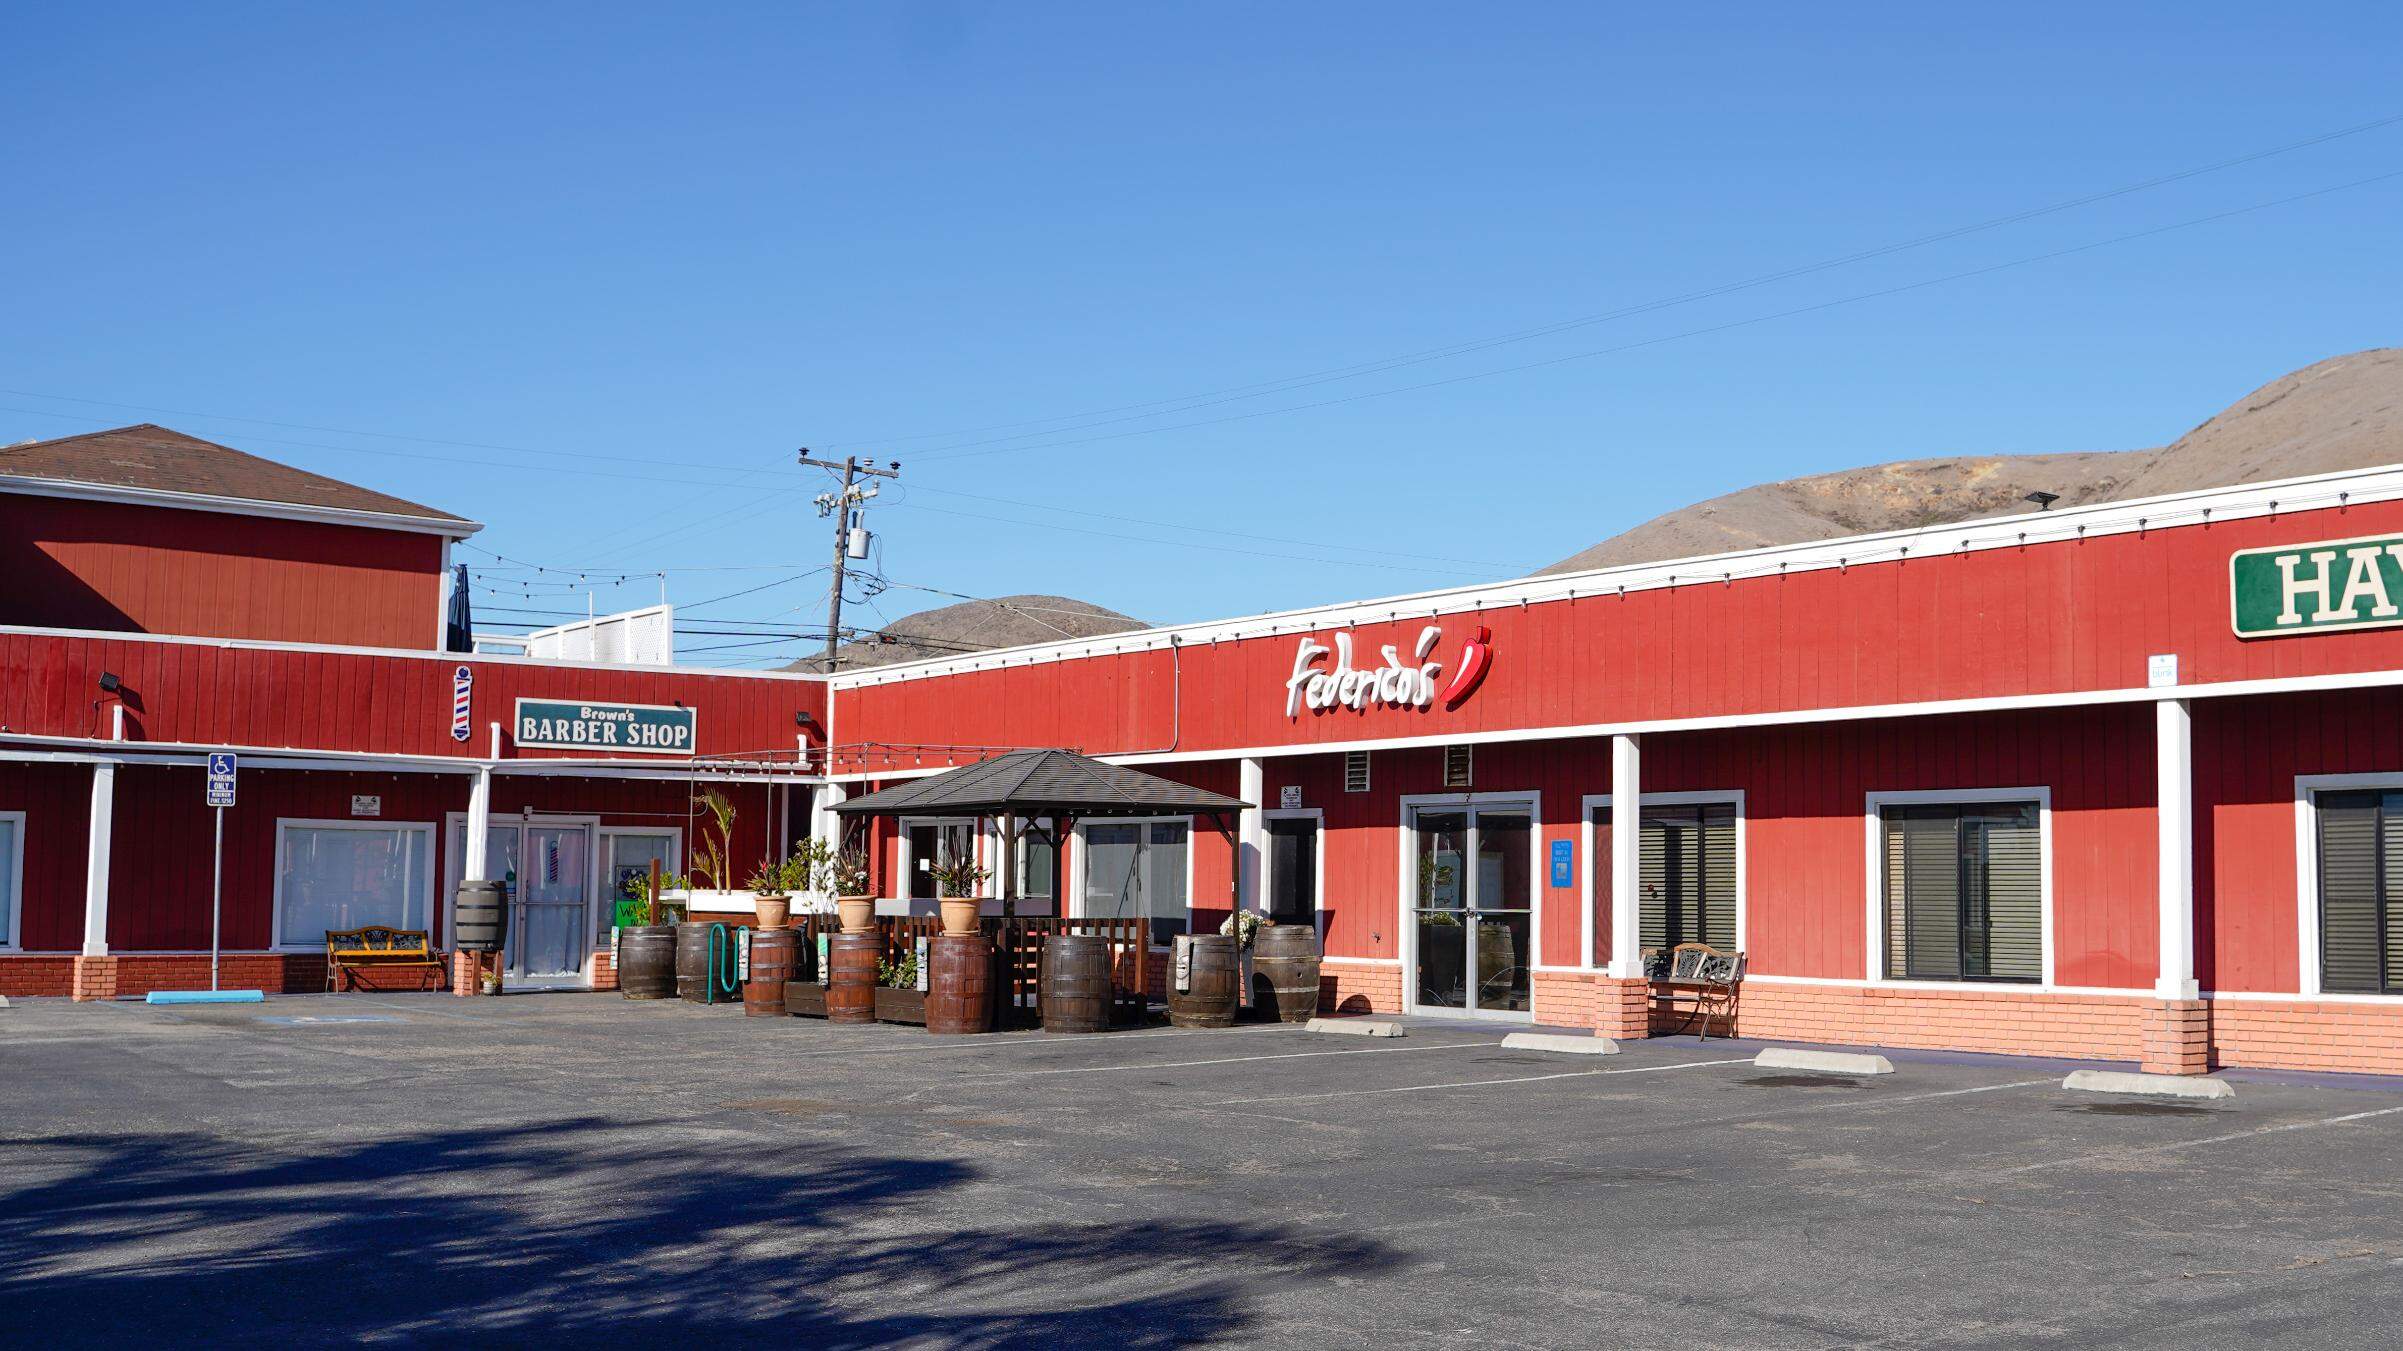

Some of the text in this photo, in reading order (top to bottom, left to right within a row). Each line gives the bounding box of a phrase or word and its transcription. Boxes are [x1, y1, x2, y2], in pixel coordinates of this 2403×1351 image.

[1286, 626, 1442, 717] Federico's
[580, 706, 635, 722] Brown's
[522, 717, 688, 746] BARBER SHOP
[209, 774, 234, 782] PARKING
[214, 782, 229, 790] ONLY
